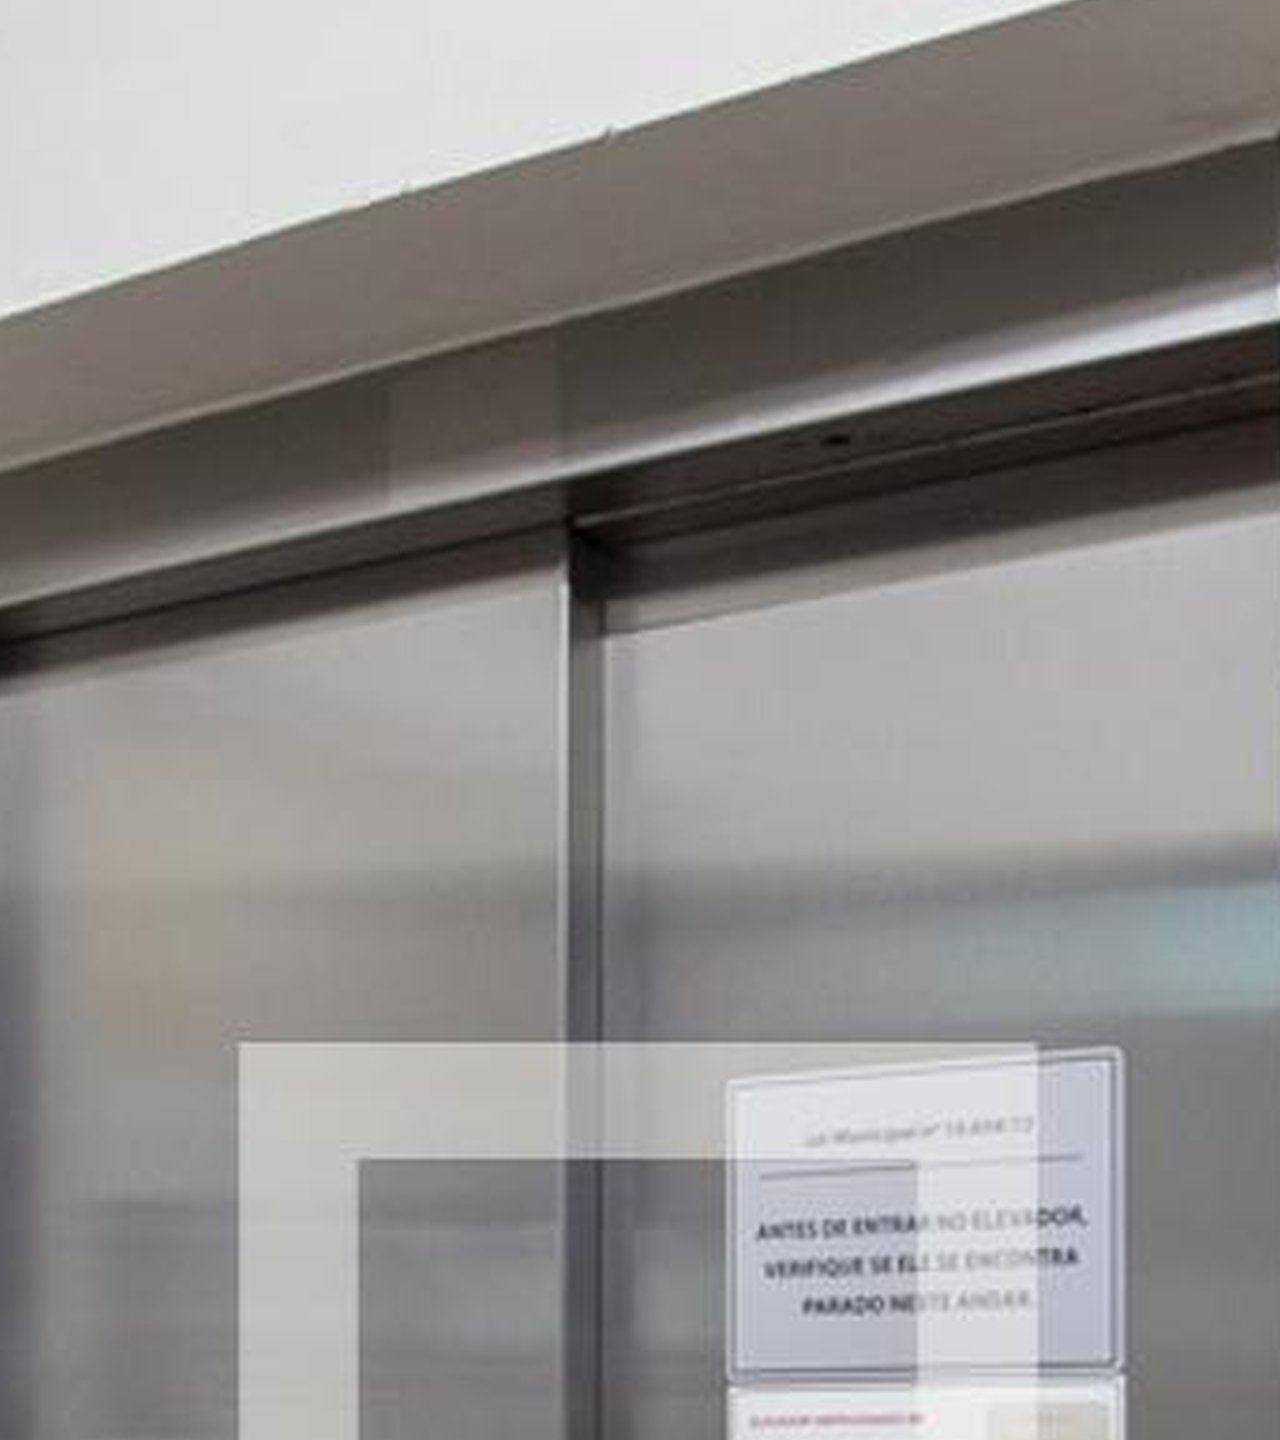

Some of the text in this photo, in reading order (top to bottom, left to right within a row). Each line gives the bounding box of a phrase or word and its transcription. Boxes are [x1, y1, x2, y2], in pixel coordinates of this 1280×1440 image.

[756, 1218, 819, 1242] ANTES
[822, 1217, 848, 1240] DE
[851, 1213, 931, 1236] ENTRAR
[936, 1211, 968, 1232] NO
[763, 1256, 864, 1280] VERIFIQUE
[869, 1254, 893, 1276] SE
[963, 1245, 1079, 1271] ENCONTRA
[801, 1292, 885, 1317] PARADO
